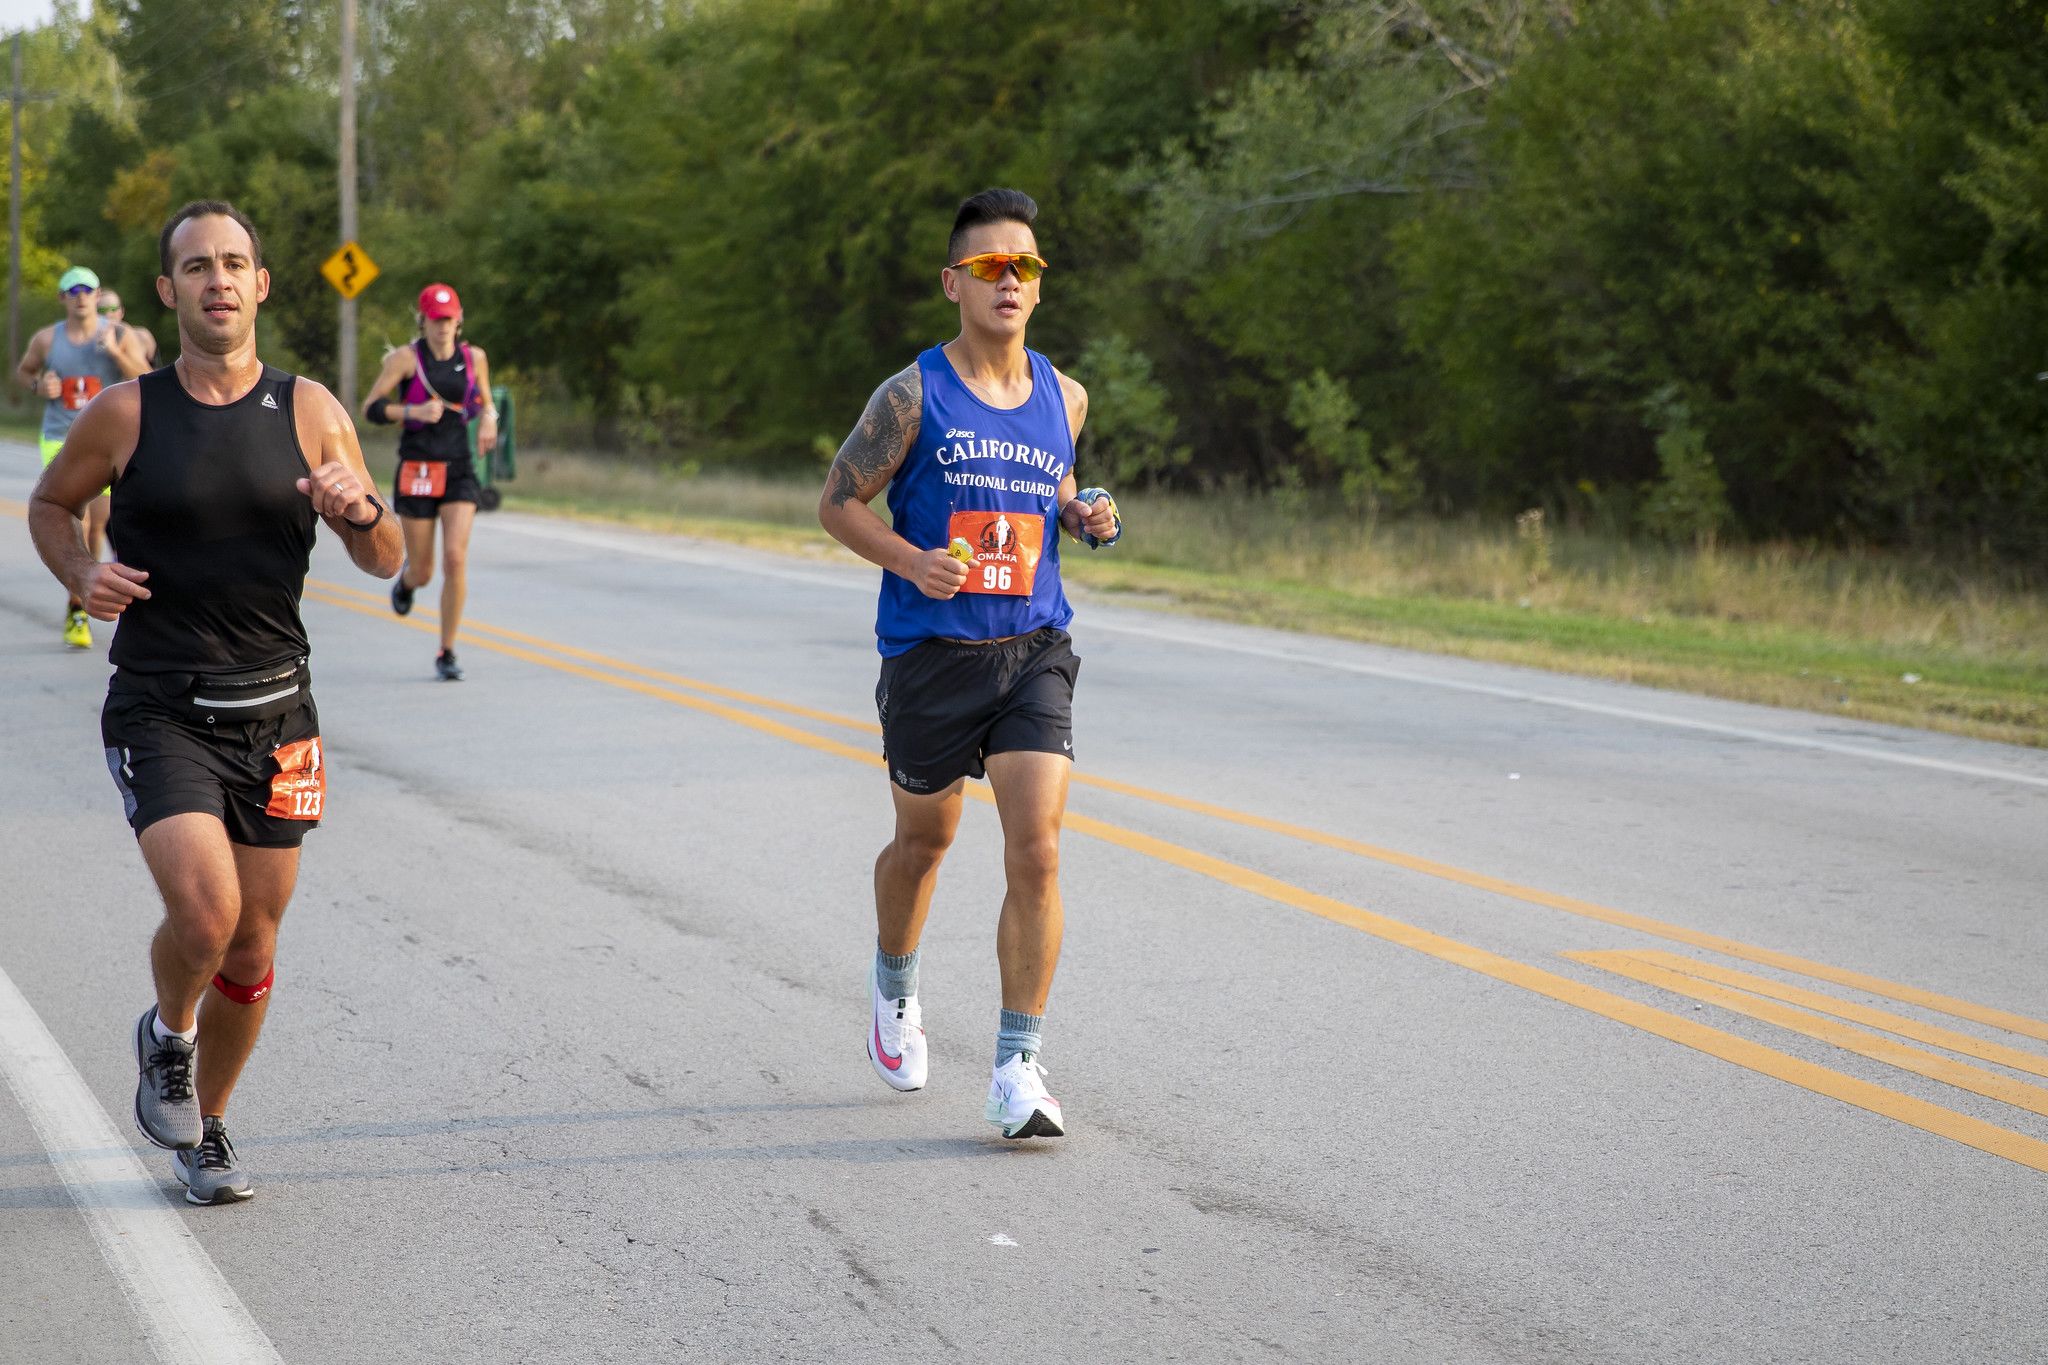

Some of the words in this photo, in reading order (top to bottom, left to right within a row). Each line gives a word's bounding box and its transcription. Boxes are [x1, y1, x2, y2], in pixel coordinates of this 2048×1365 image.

[936, 439, 1065, 482] CALIFORNIA
[944, 471, 1008, 491] NATIONAL
[1010, 479, 1055, 497] GUARD
[977, 552, 1018, 563] OMAHA
[983, 565, 1012, 590] 96
[293, 791, 321, 816] 123
